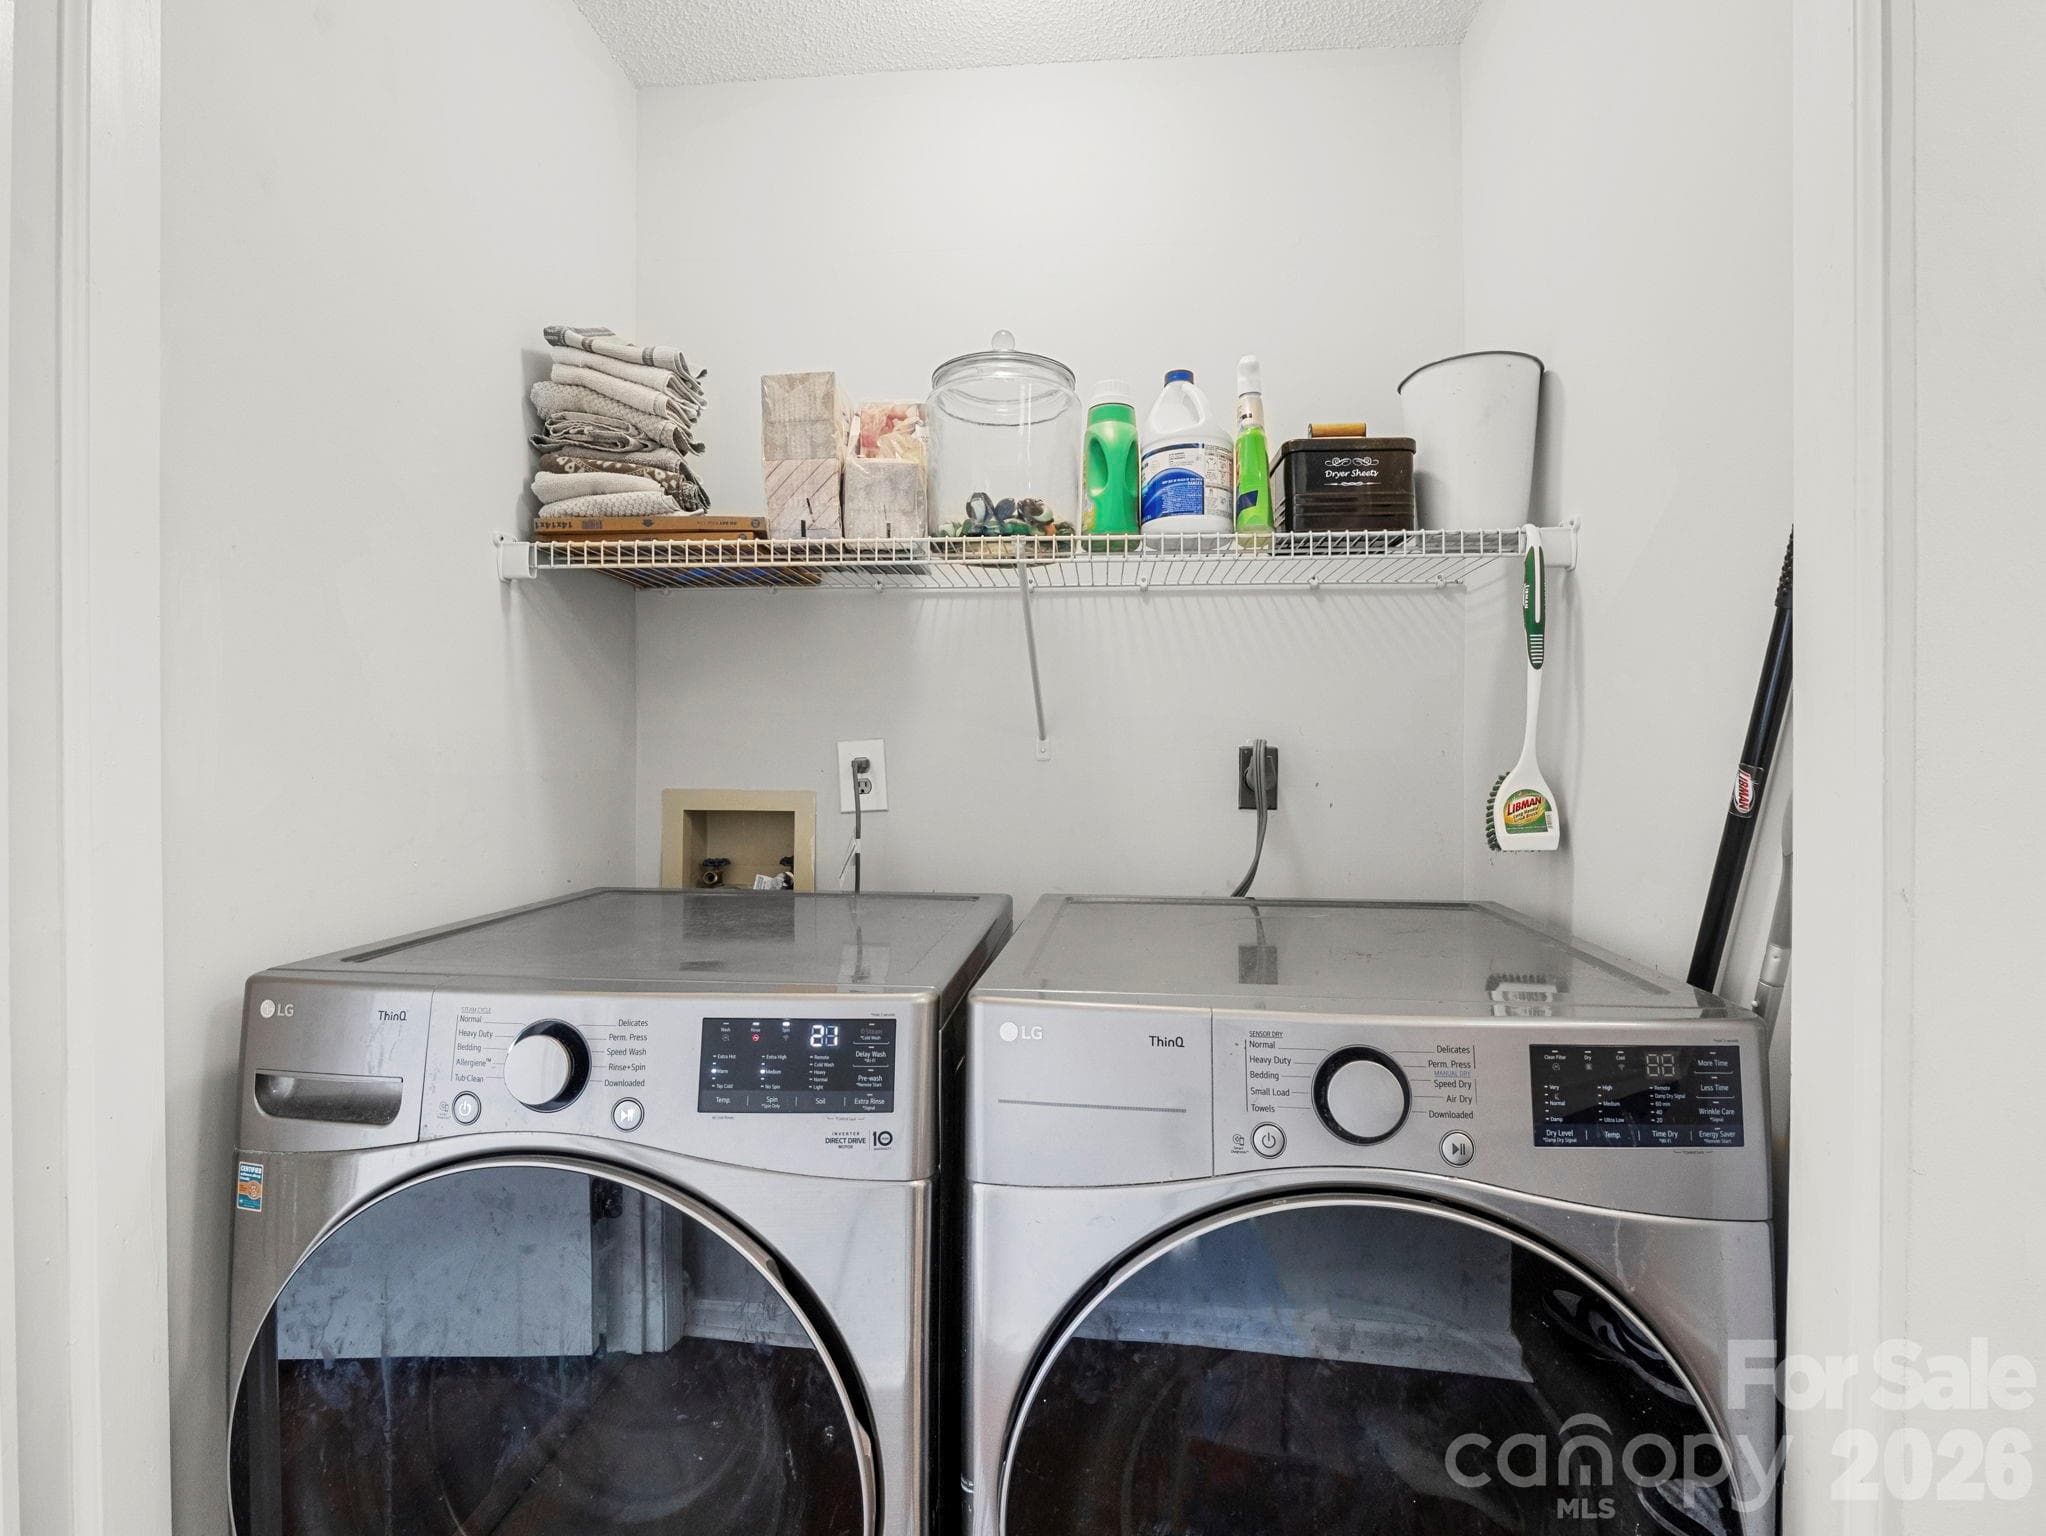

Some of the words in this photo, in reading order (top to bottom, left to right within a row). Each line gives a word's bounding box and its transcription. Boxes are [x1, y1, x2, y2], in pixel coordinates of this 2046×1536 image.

[1325, 470, 1350, 479] Dryer
[1351, 469, 1379, 477] Sheets
[1507, 797, 1542, 816] LIBMAN
[277, 1003, 294, 1017] LG
[378, 1010, 407, 1021] ThinQ
[459, 1015, 482, 1023] Normal
[618, 1019, 648, 1027] Delicates
[458, 1029, 477, 1038] Heavy
[479, 1029, 493, 1039] Duty
[608, 1033, 628, 1041] Perm.
[629, 1033, 648, 1041] Press
[810, 1024, 839, 1047] 21
[1021, 1025, 1043, 1040] LG
[1149, 1035, 1185, 1048] ThinQ
[1249, 1040, 1276, 1049] Normal
[457, 1042, 482, 1053] Bedding
[606, 1047, 627, 1057] Speed
[629, 1048, 647, 1056] Wash
[1436, 1045, 1471, 1054] Delicates
[855, 1050, 870, 1058] Delay
[1249, 1055, 1272, 1065] Heavy
[1274, 1055, 1292, 1066] Duty
[1428, 1060, 1448, 1068] Perm.
[1450, 1060, 1472, 1069] Press
[1697, 1059, 1713, 1067] More
[1714, 1059, 1729, 1067] Time
[608, 1063, 646, 1073] Rinse+Spin
[455, 1073, 465, 1082] Tub
[467, 1074, 484, 1083] Clean
[857, 1074, 883, 1082] Pre-wash
[1249, 1070, 1280, 1081] Bedding
[604, 1079, 646, 1087] Downloaded
[1434, 1080, 1457, 1089] Speed
[1458, 1080, 1472, 1090] Dry
[1250, 1086, 1271, 1096] Small
[1272, 1087, 1290, 1096] Load
[766, 1096, 779, 1104] Spin
[815, 1097, 826, 1105] Soil
[854, 1097, 869, 1105] Extra
[870, 1097, 885, 1105] Rinse
[1446, 1095, 1457, 1103] Air
[1459, 1095, 1473, 1105] Dry
[1251, 1103, 1276, 1113] Towels
[1428, 1110, 1474, 1119] Downloaded
[1546, 1129, 1557, 1137] Dry
[1667, 1130, 1679, 1139] Dry
[1698, 1130, 1719, 1139] Energy
[1719, 1130, 1736, 1138] Saver
[872, 1130, 893, 1147] 10
